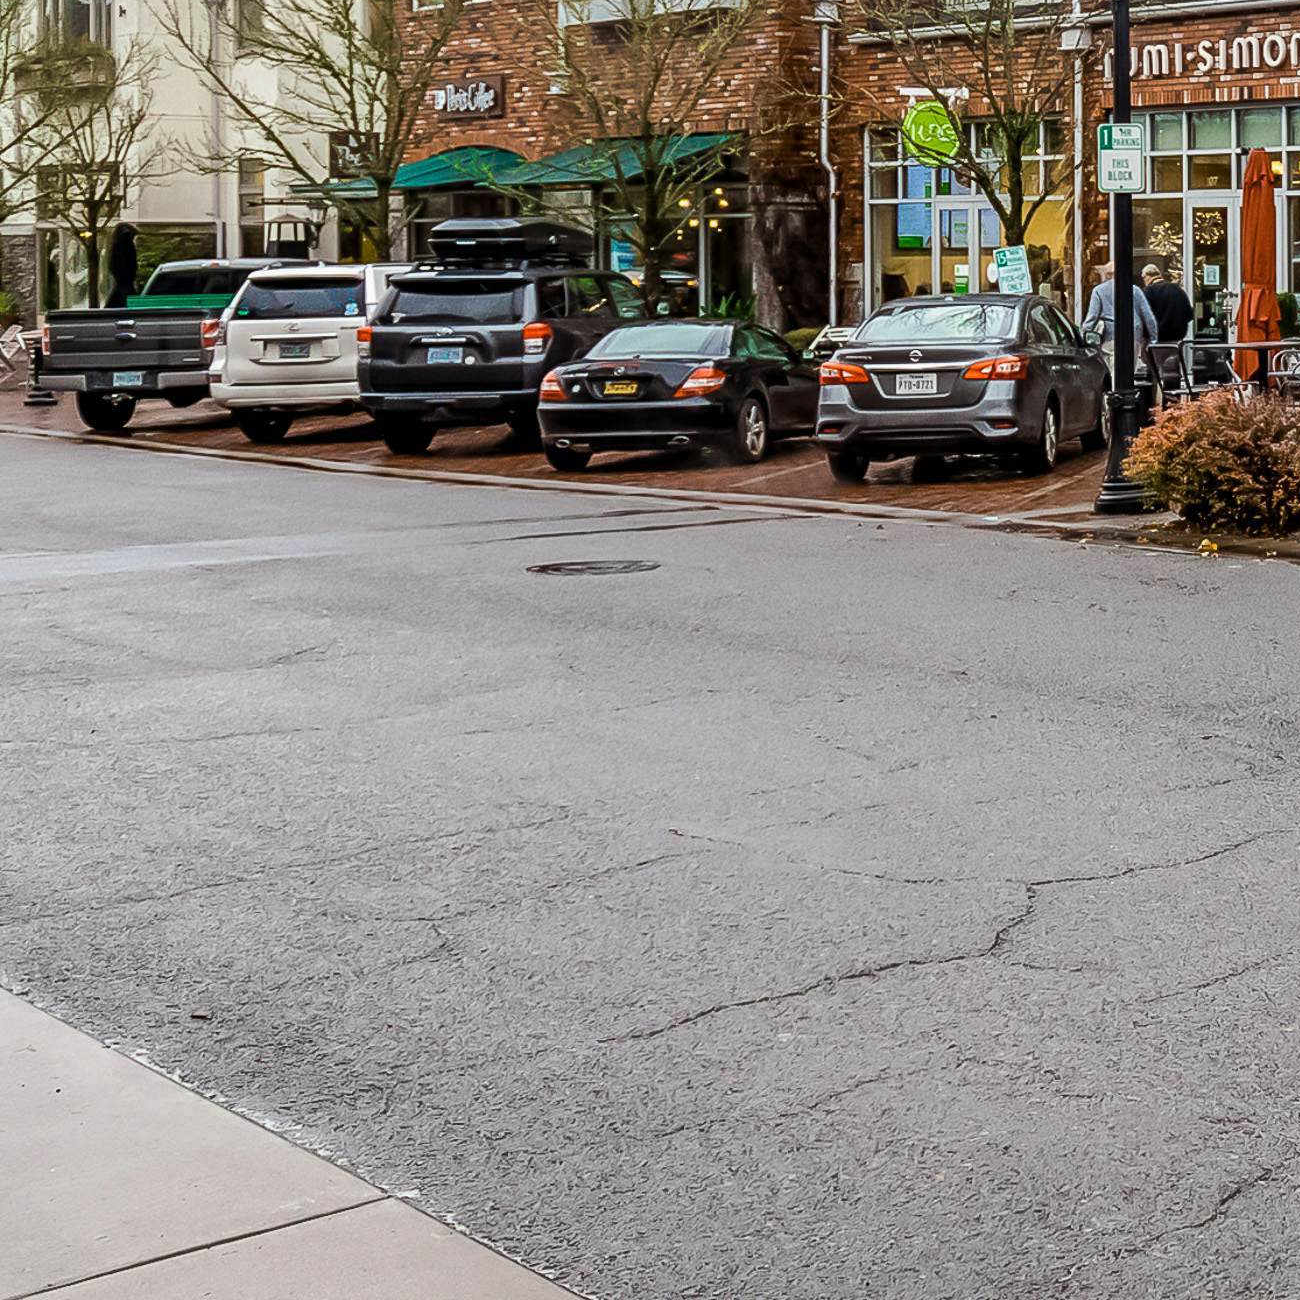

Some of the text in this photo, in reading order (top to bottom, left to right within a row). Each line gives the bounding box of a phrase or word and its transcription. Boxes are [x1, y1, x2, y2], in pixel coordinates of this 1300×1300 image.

[1103, 129, 1109, 146] 1
[1113, 137, 1140, 147] PARKING
[1112, 158, 1129, 169] THIS
[1107, 170, 1133, 181] BLOCK
[996, 251, 1007, 266] 15
